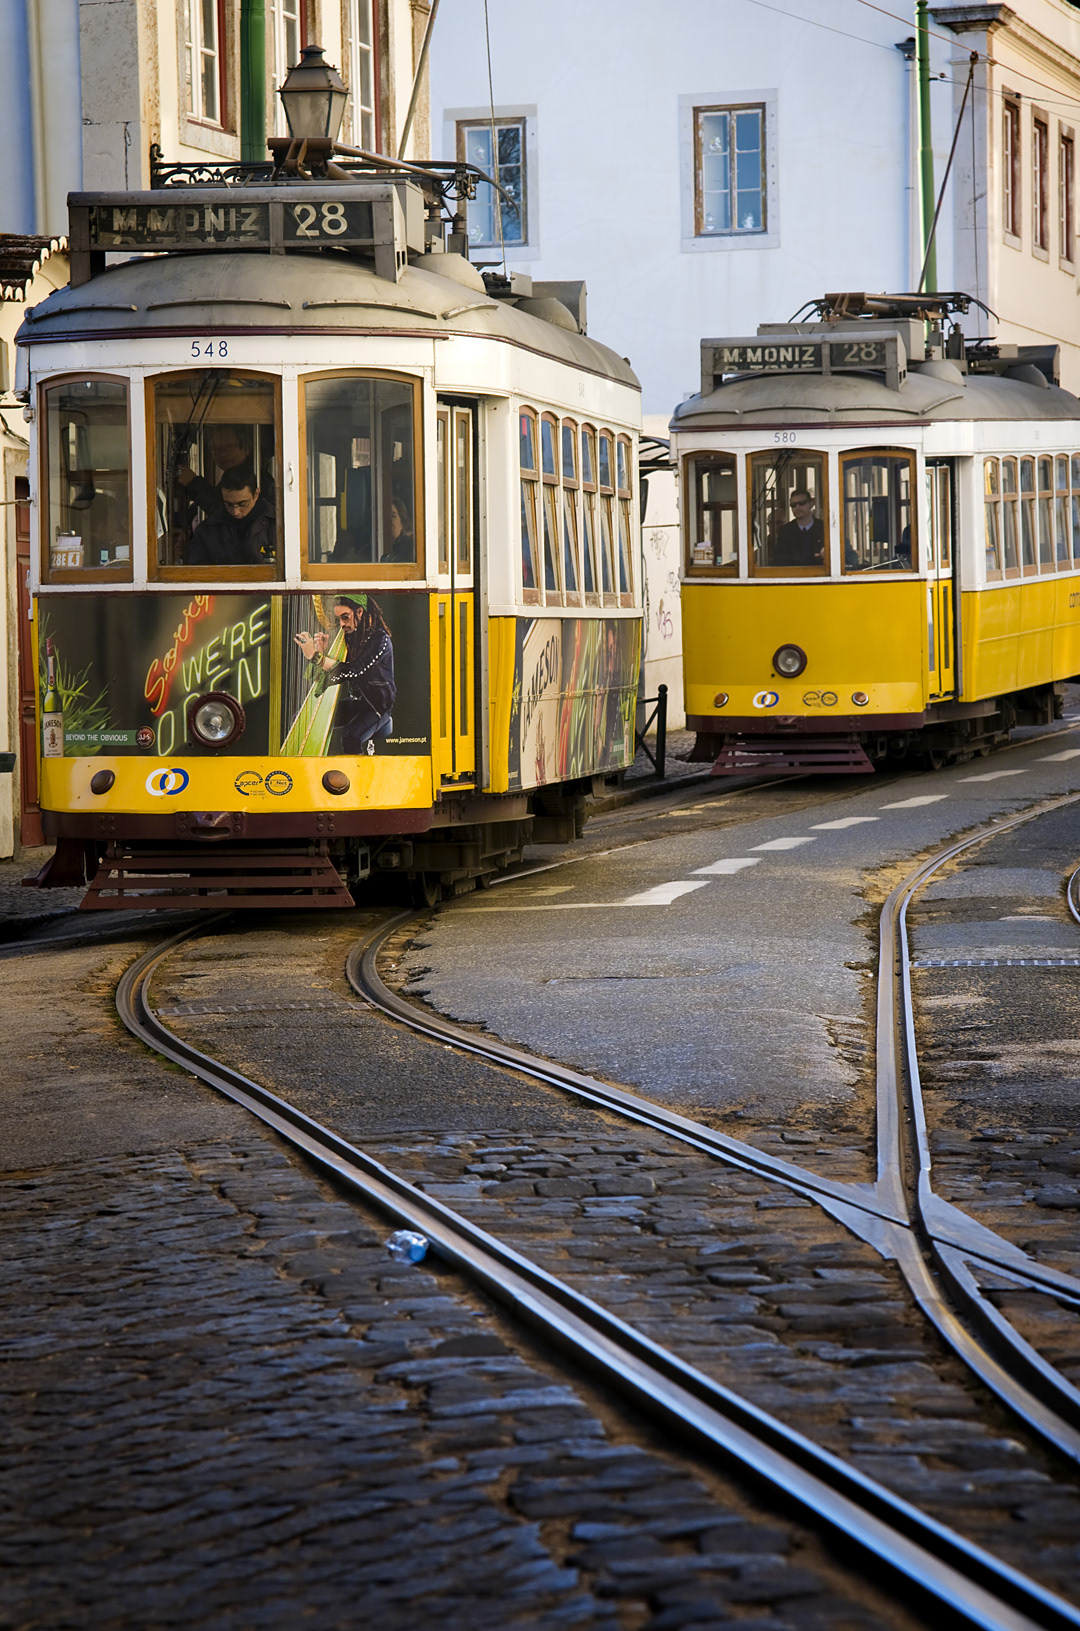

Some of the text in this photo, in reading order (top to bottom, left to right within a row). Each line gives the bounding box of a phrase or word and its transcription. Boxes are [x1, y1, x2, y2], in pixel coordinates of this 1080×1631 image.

[293, 201, 349, 237] 28
[190, 340, 229, 357] 548
[843, 343, 877, 362] 28
[774, 432, 797, 443] 580
[182, 603, 268, 693] WE'RE
[65, 733, 86, 741] BEYOND
[100, 734, 128, 742] OBVIOUS
[385, 736, 427, 744] www.jameson.pt
